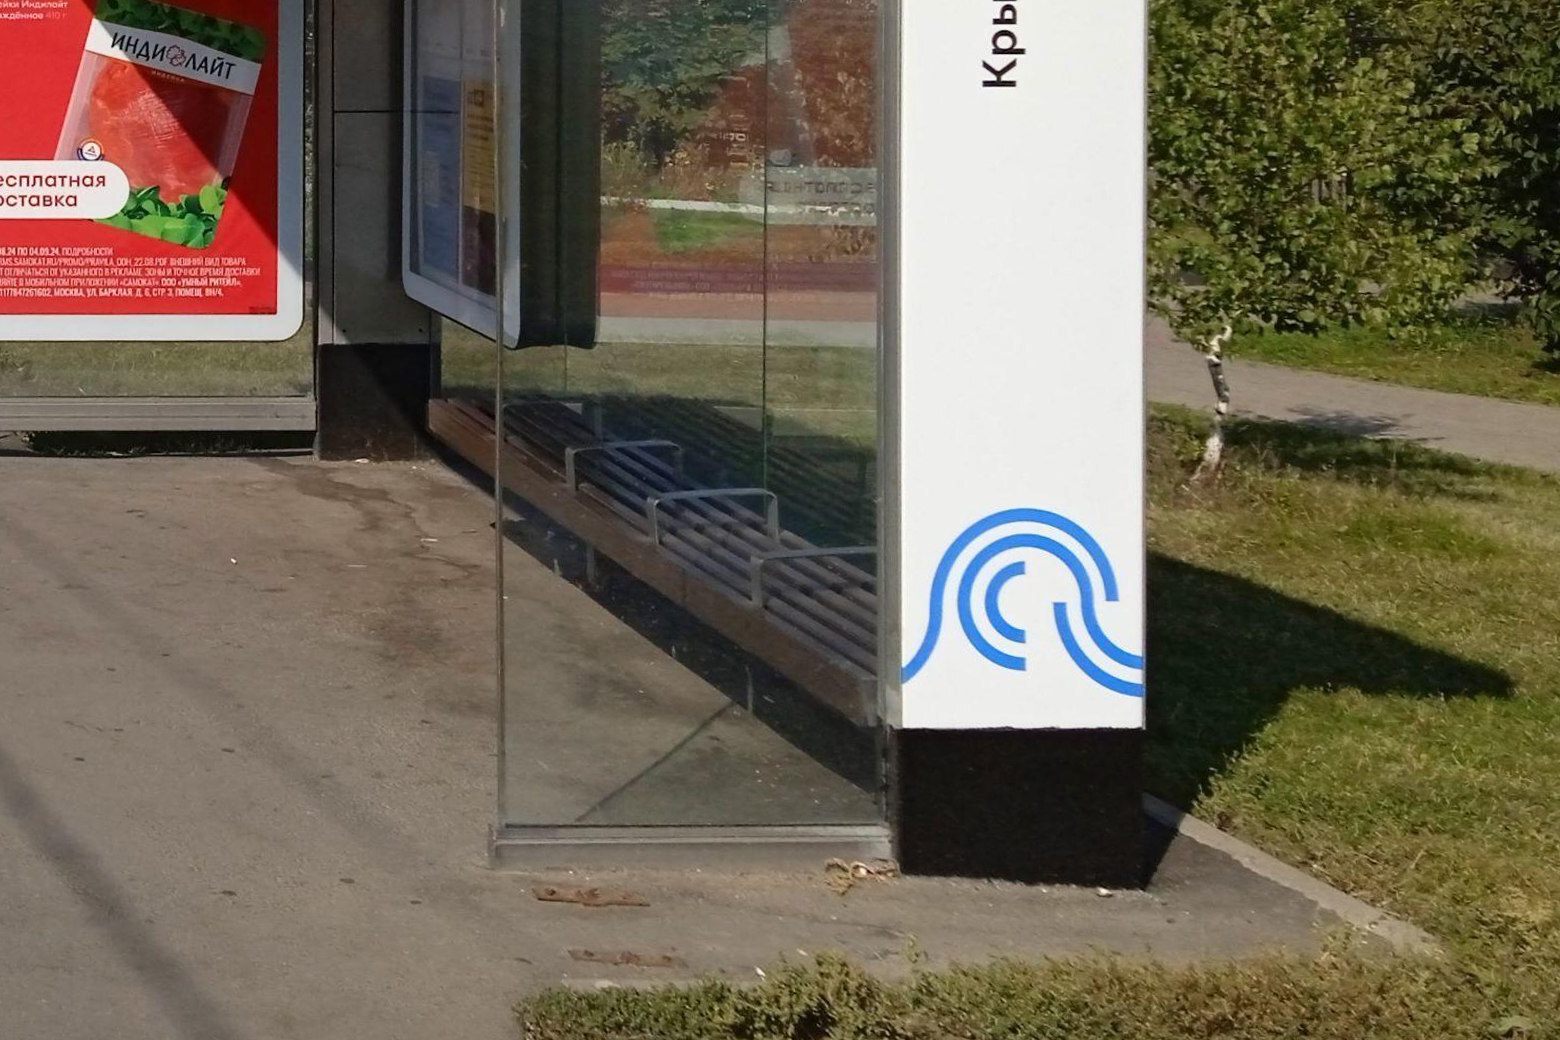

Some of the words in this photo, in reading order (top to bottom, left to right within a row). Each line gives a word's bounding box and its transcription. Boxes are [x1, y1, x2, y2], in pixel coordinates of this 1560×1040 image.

[17, 247, 28, 257] ПО
[62, 247, 113, 257] ПОДРОБНОСТИ
[220, 257, 247, 266] ТОВАРА
[200, 267, 224, 276] ВРЕМЯ
[161, 277, 176, 287] ООО
